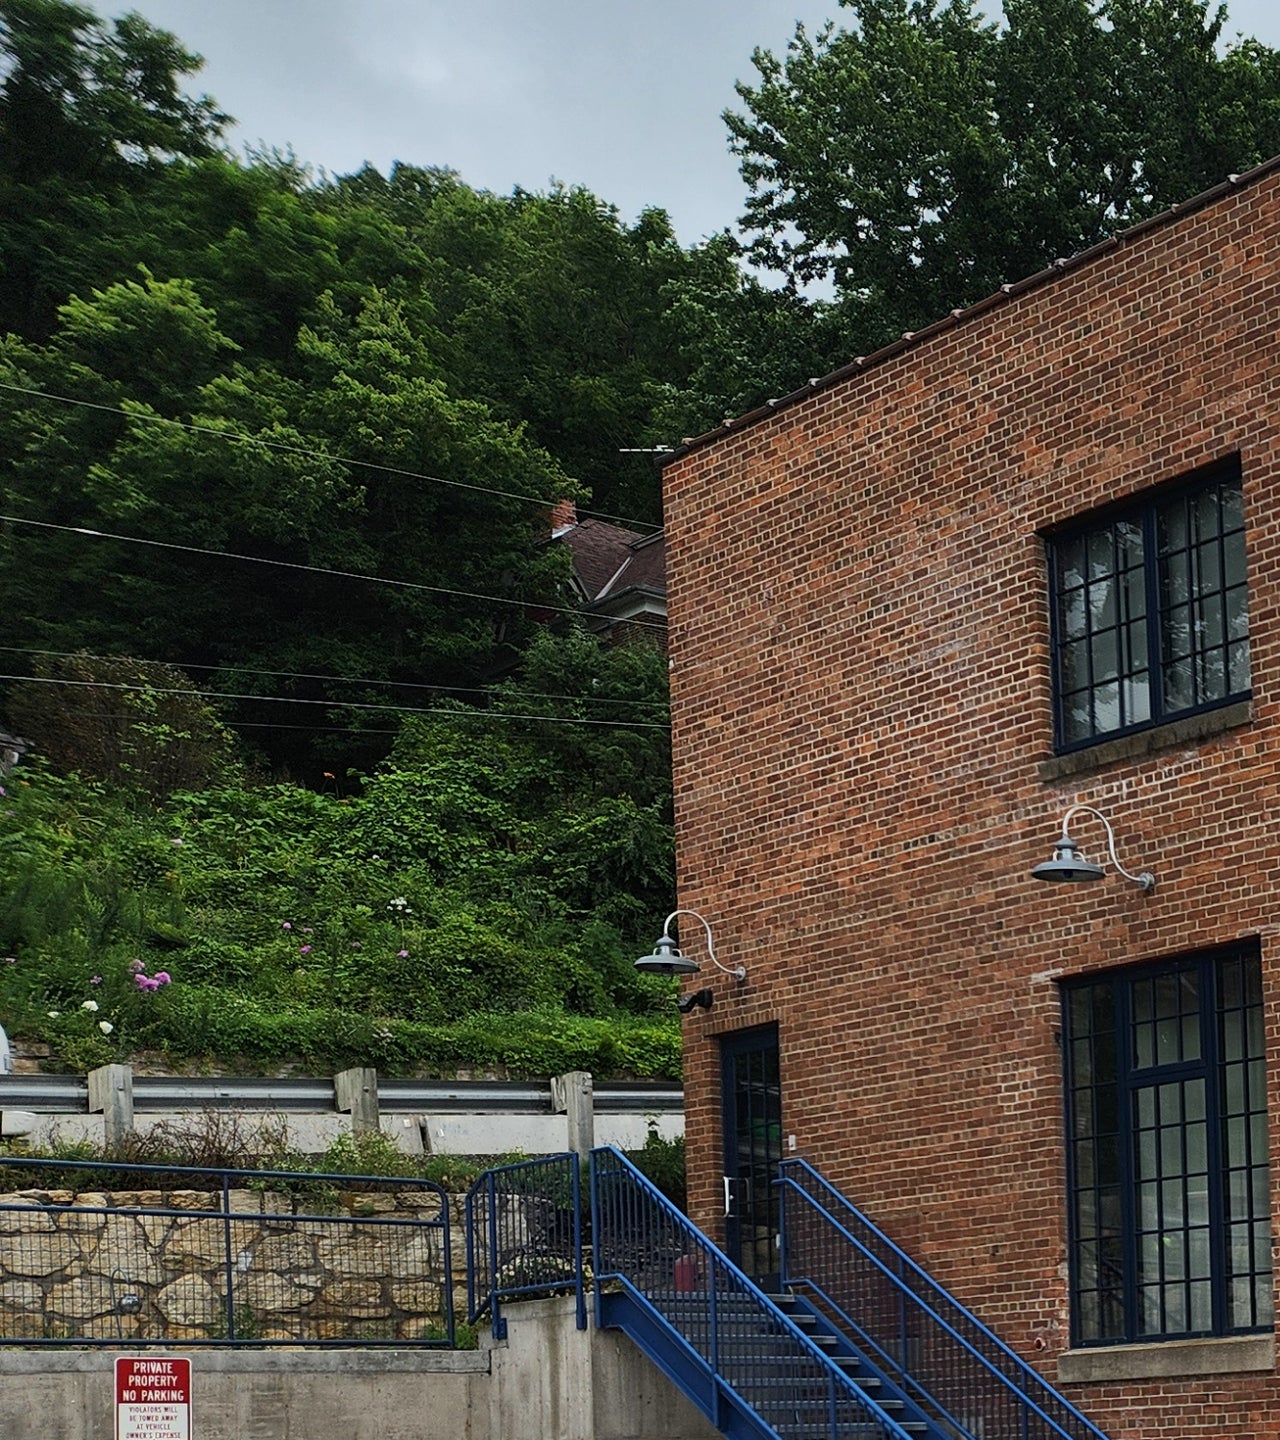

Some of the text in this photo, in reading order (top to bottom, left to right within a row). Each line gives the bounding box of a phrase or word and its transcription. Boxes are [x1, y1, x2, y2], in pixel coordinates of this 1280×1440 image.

[133, 1361, 173, 1374] PRIVATE
[128, 1375, 178, 1387] PROPERTY
[122, 1389, 184, 1401] NO PARKING
